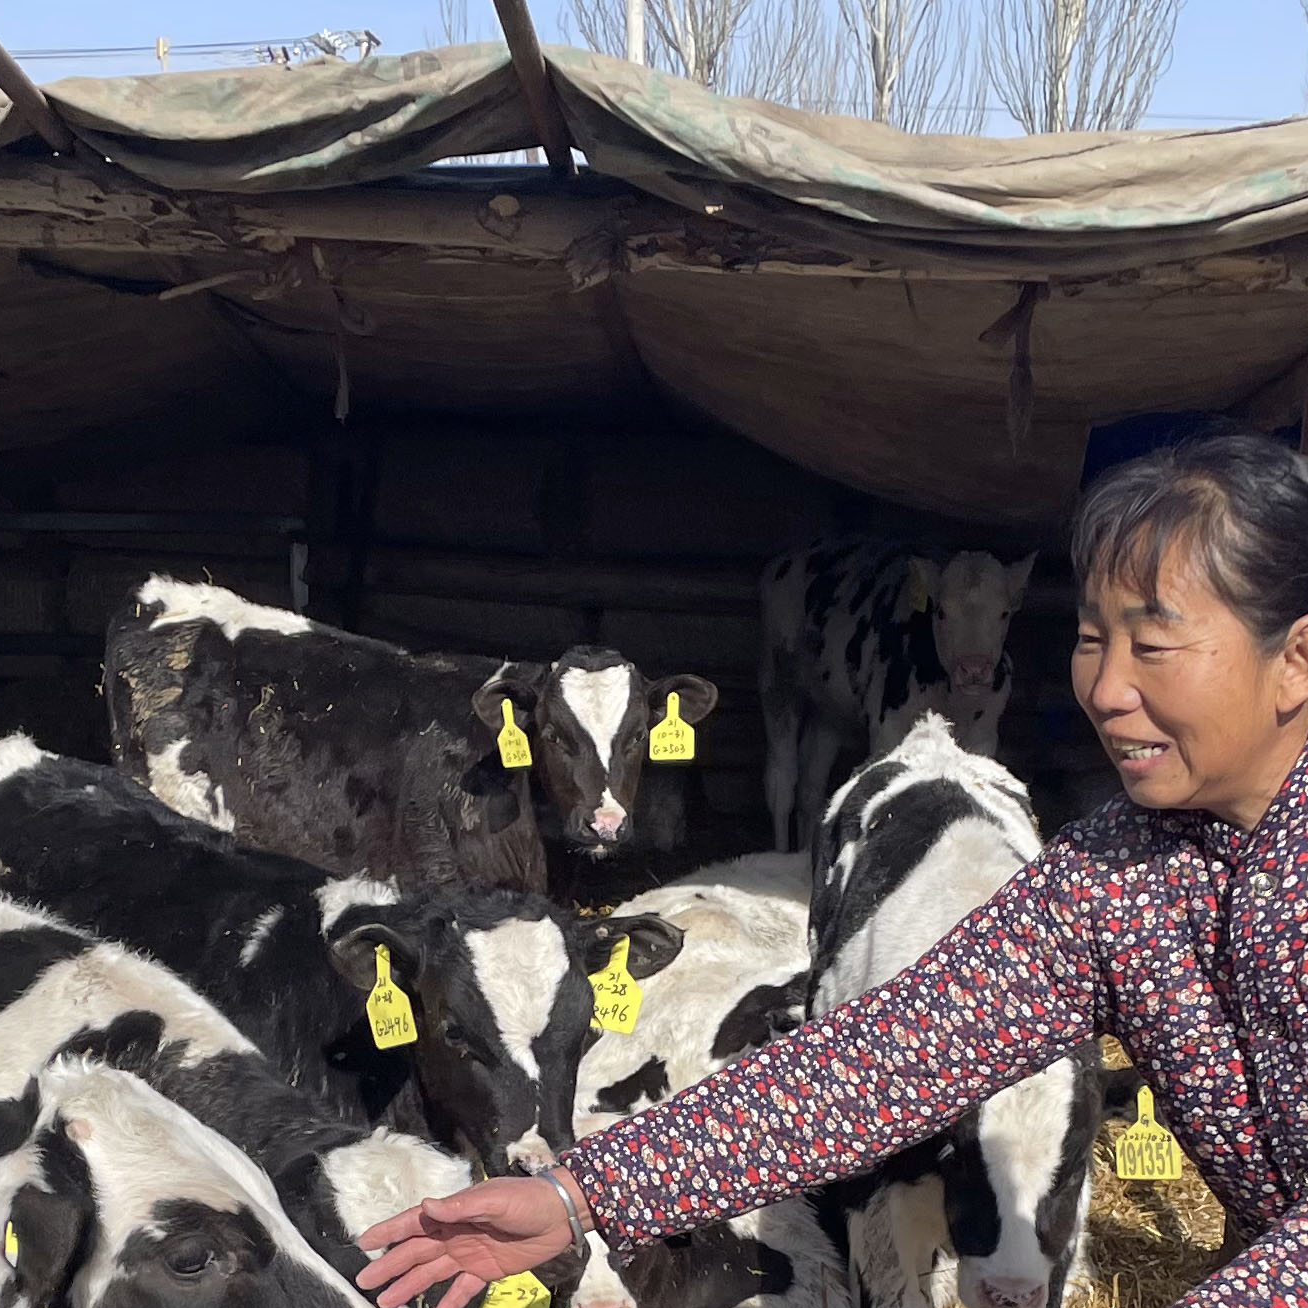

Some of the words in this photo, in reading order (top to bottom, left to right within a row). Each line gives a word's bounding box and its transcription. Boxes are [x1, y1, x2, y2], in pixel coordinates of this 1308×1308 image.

[653, 744, 686, 755] G2503
[609, 973, 620, 983] 21
[593, 984, 628, 996] 10-28
[594, 1004, 630, 1022] 2496
[376, 1013, 409, 1036] G2496
[1140, 1114, 1151, 1128] G
[1119, 1142, 1175, 1176] 191351
